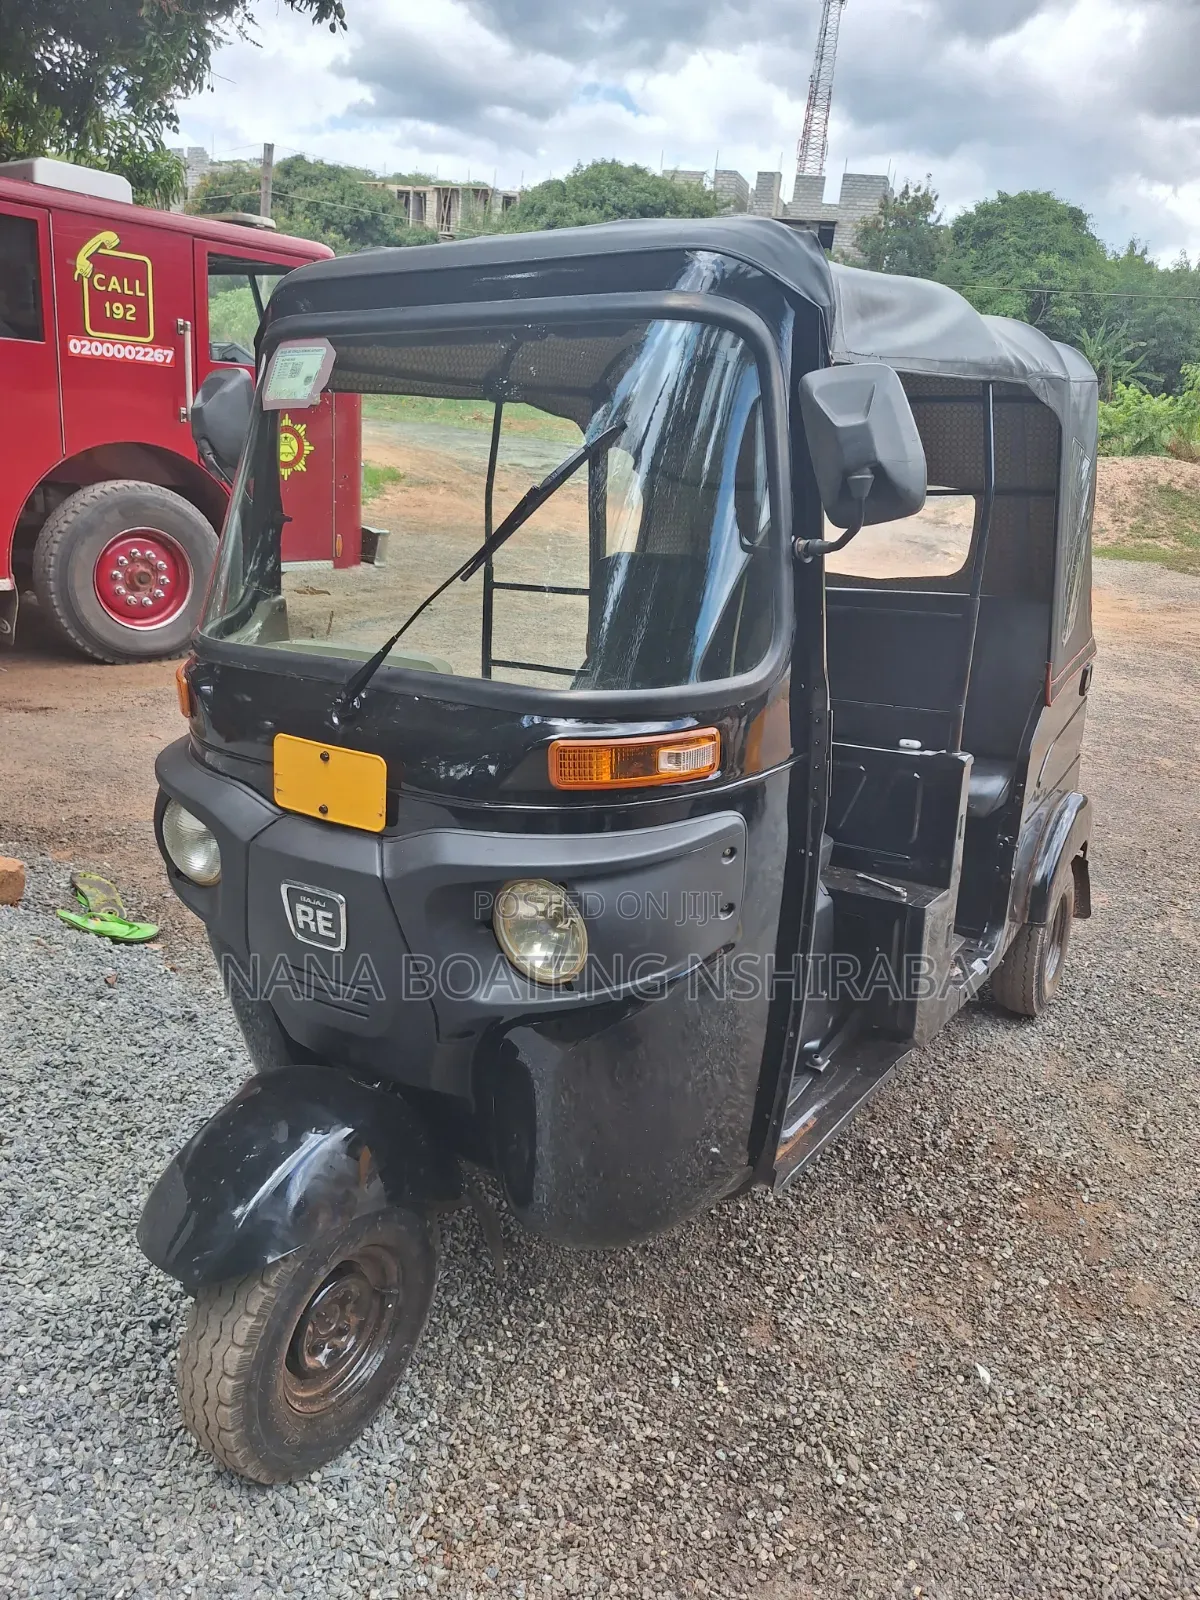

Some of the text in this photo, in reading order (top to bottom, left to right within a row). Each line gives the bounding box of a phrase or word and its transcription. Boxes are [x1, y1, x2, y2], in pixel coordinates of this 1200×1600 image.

[93, 273, 145, 296] CALL
[104, 301, 136, 320] 192
[69, 339, 173, 363] 0200002267
[301, 896, 325, 907] BAJAJ
[296, 903, 336, 938] RE
